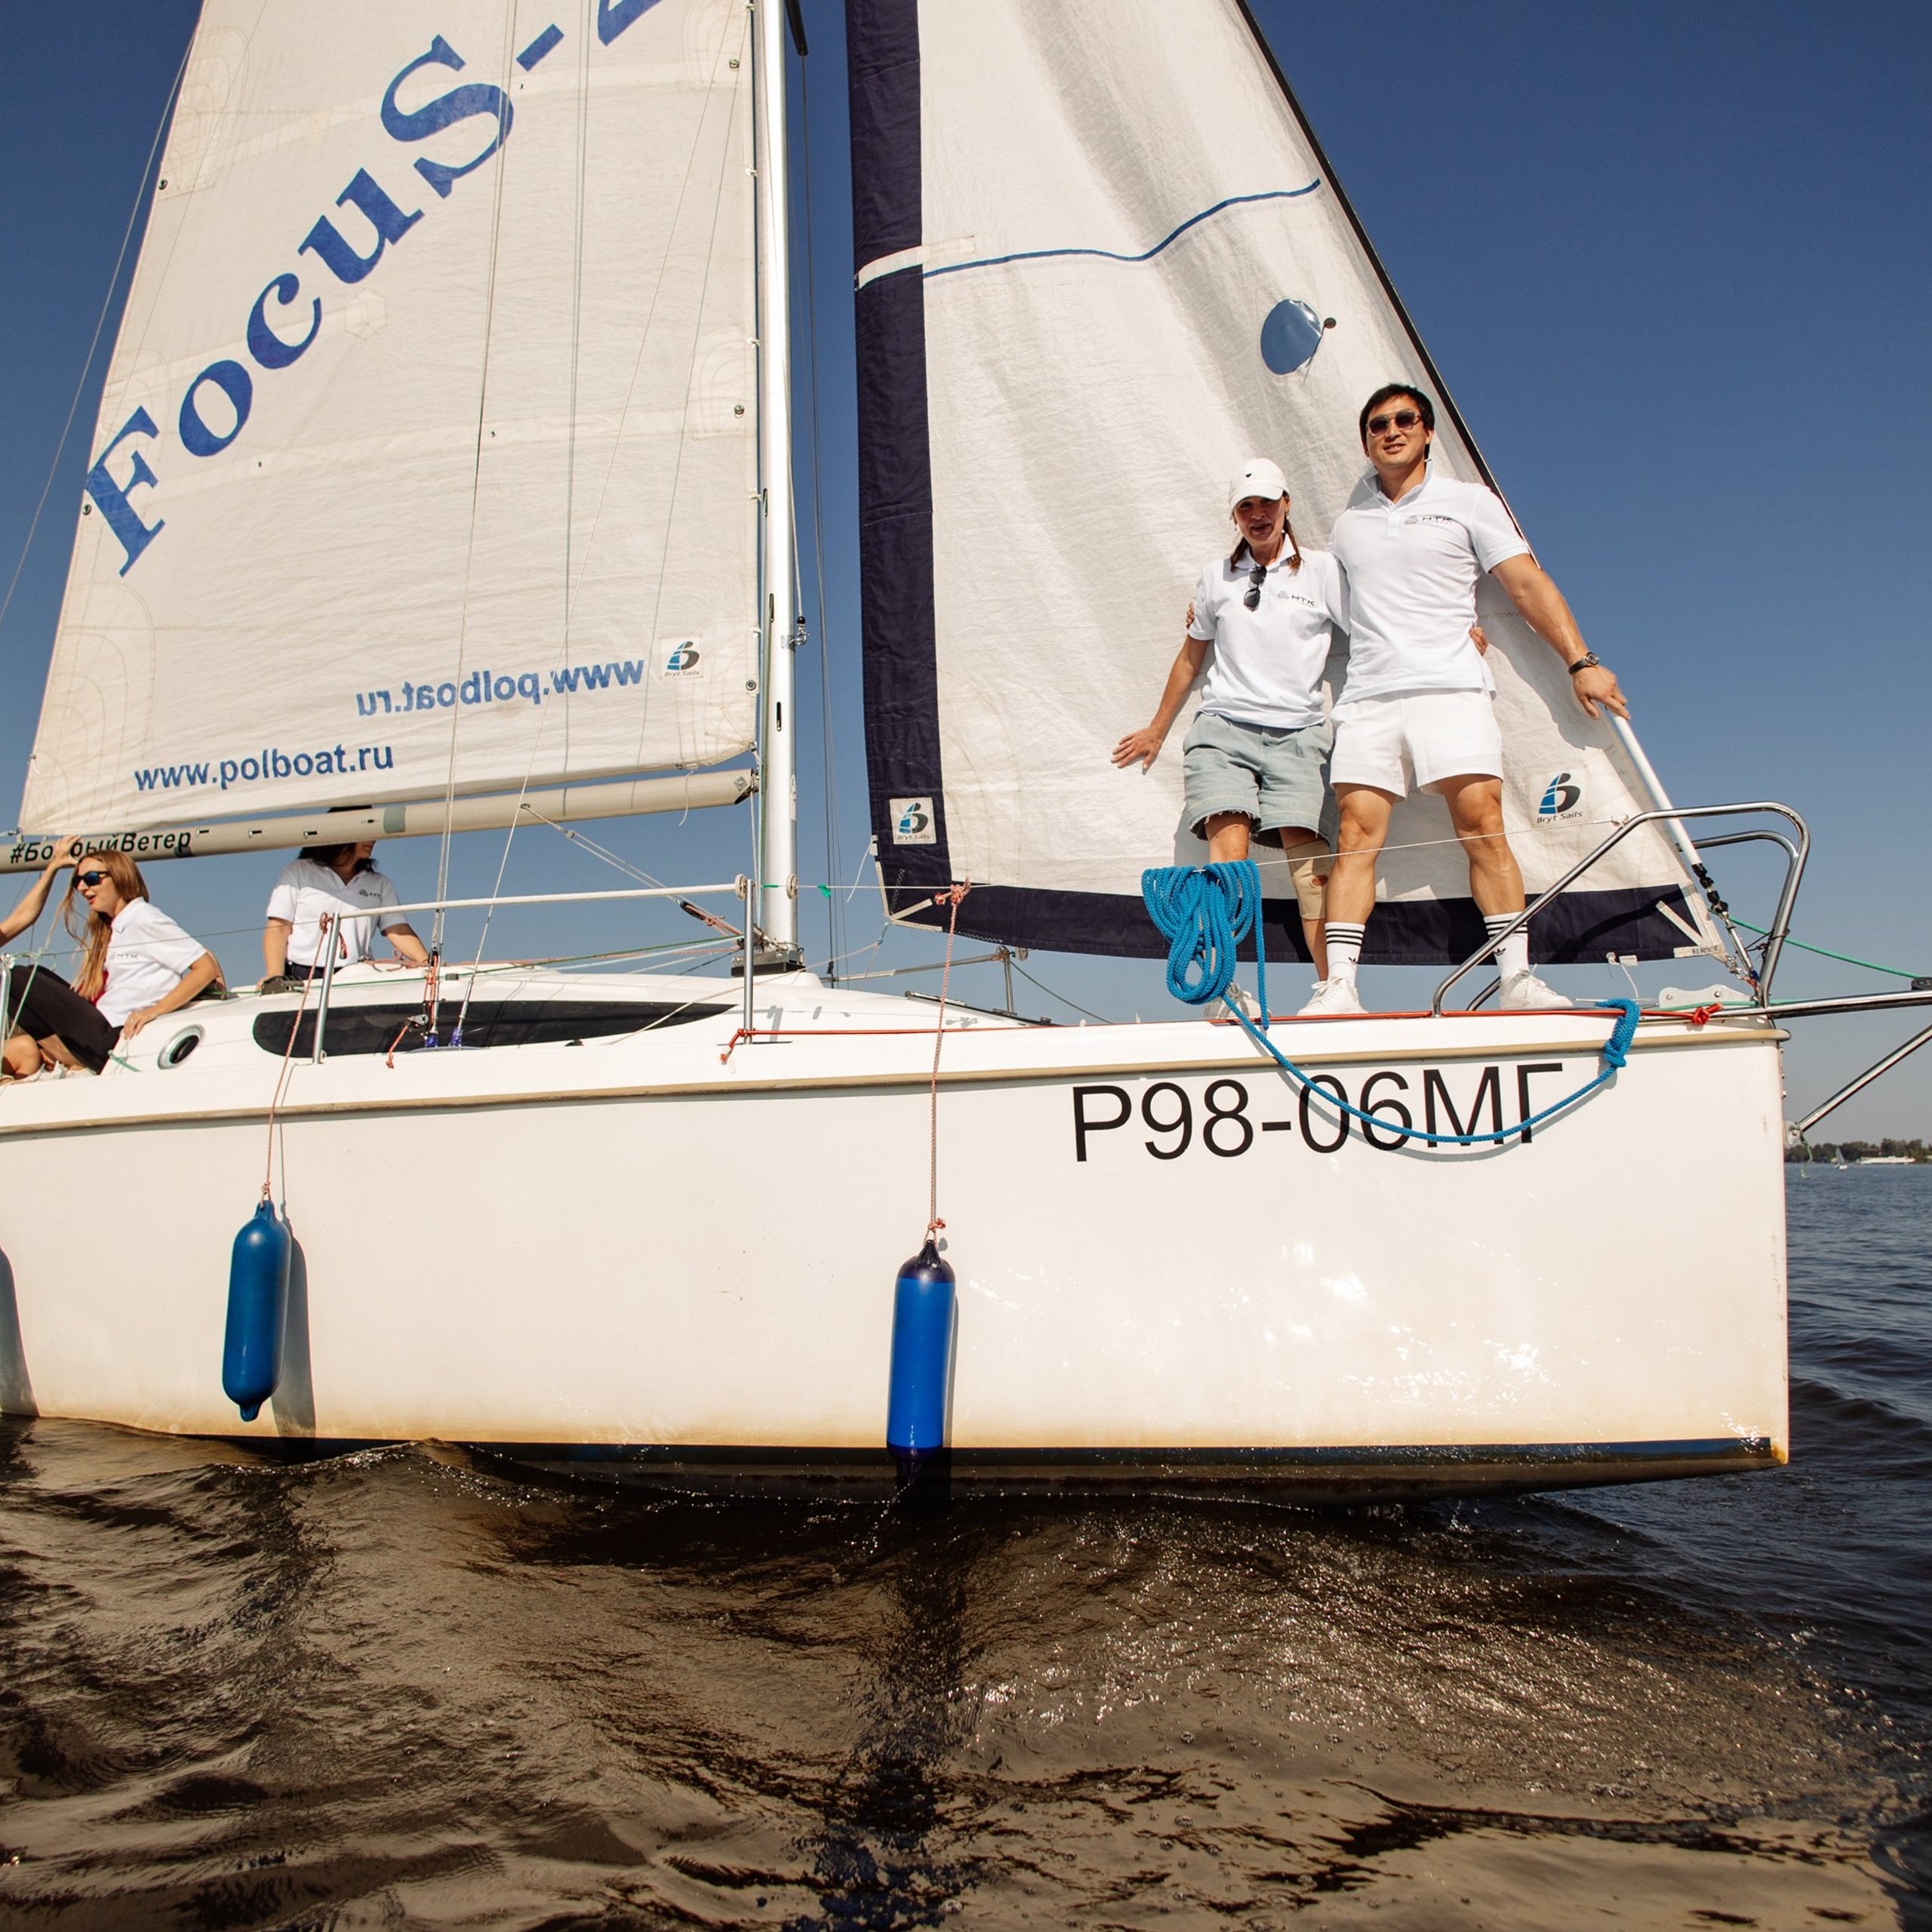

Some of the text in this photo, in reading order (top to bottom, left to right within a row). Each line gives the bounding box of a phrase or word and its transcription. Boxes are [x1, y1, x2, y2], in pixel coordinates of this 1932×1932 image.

[85, 0, 664, 577] FocuS-
[134, 743, 394, 790] www.polboat.ru
[1537, 811, 1583, 824] Bryt Sails
